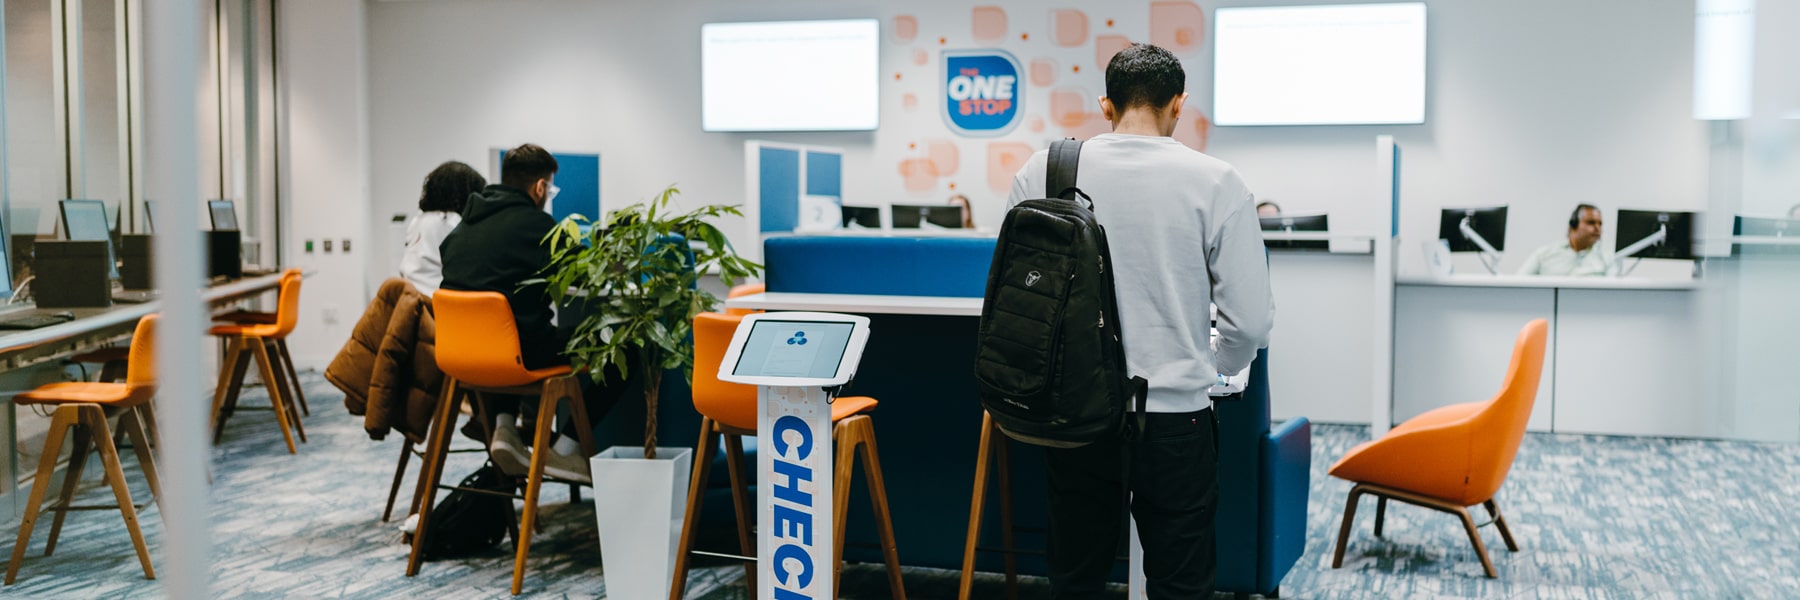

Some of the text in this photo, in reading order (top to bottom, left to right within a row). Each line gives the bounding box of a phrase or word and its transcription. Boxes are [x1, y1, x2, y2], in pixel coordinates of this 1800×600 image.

[948, 75, 1016, 101] ONE
[958, 99, 1012, 116] STOP
[772, 415, 814, 600] CHEC
